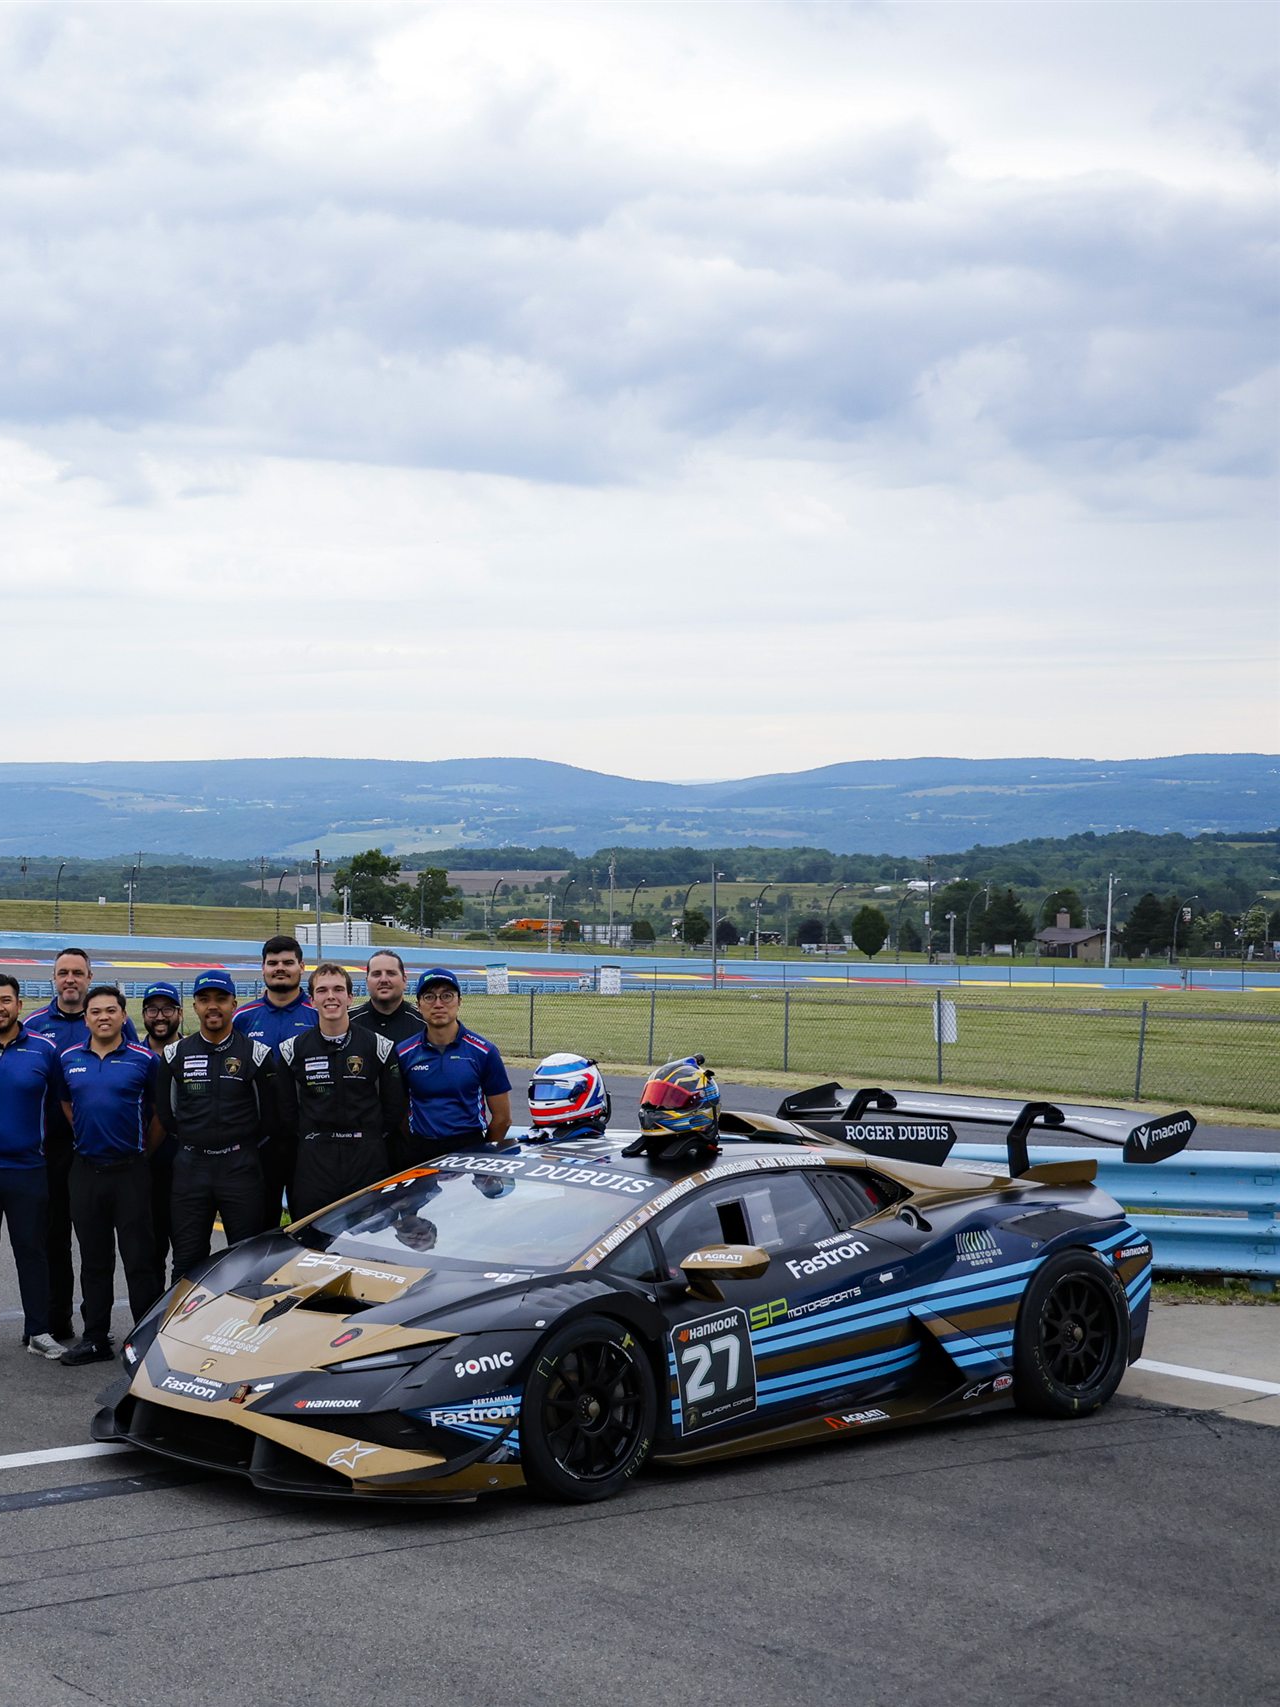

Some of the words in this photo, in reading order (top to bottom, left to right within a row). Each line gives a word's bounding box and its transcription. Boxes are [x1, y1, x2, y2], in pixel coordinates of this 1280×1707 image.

[845, 1125, 895, 1141] ROGER
[897, 1125, 949, 1141] DUBUIS
[1151, 1119, 1191, 1142] macron
[430, 1155, 526, 1175] ROGER
[525, 1164, 654, 1194] DUBUIS
[701, 1159, 759, 1182] LAMBORGHINI
[758, 1157, 777, 1169] SAN
[776, 1155, 826, 1168] FRANCISCO
[656, 1177, 697, 1211] CONWRIGHT
[604, 1220, 638, 1253] MORILLO
[814, 1232, 854, 1250] PERTAMINA
[703, 1252, 743, 1261] AGRATI
[785, 1240, 870, 1280] Fastron
[749, 1297, 788, 1331] SP
[787, 1286, 862, 1319] MOTORSPORTS
[681, 1333, 740, 1404] 27
[160, 1375, 218, 1400] Fastron
[472, 1394, 514, 1406] PERTAMINA
[430, 1404, 516, 1427] Fastron
[842, 1408, 887, 1424] AGRATI
